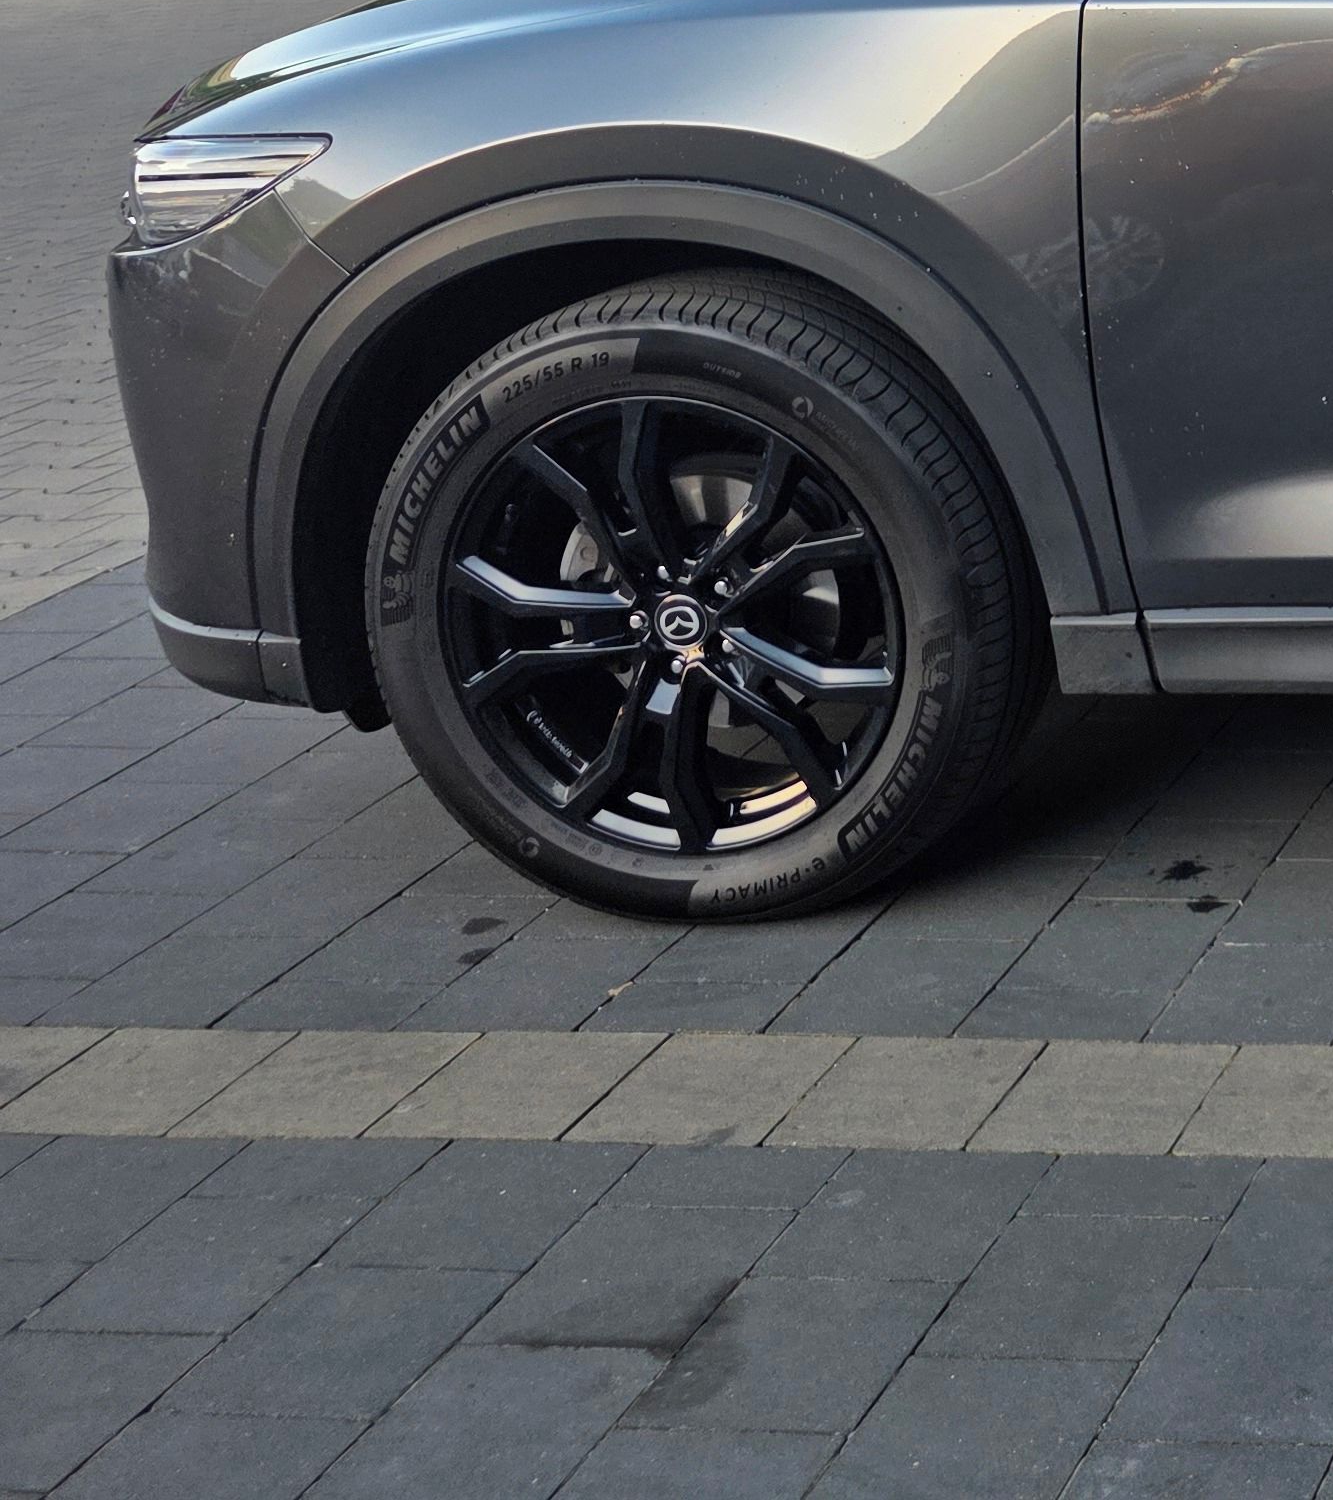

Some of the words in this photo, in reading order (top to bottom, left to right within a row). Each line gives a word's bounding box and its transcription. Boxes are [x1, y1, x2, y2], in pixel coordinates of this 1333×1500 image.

[502, 360, 564, 403] 225/55
[571, 358, 583, 373] R
[591, 351, 610, 369] 19
[389, 405, 481, 566] MICHELIN
[844, 695, 943, 850] MICHELIN
